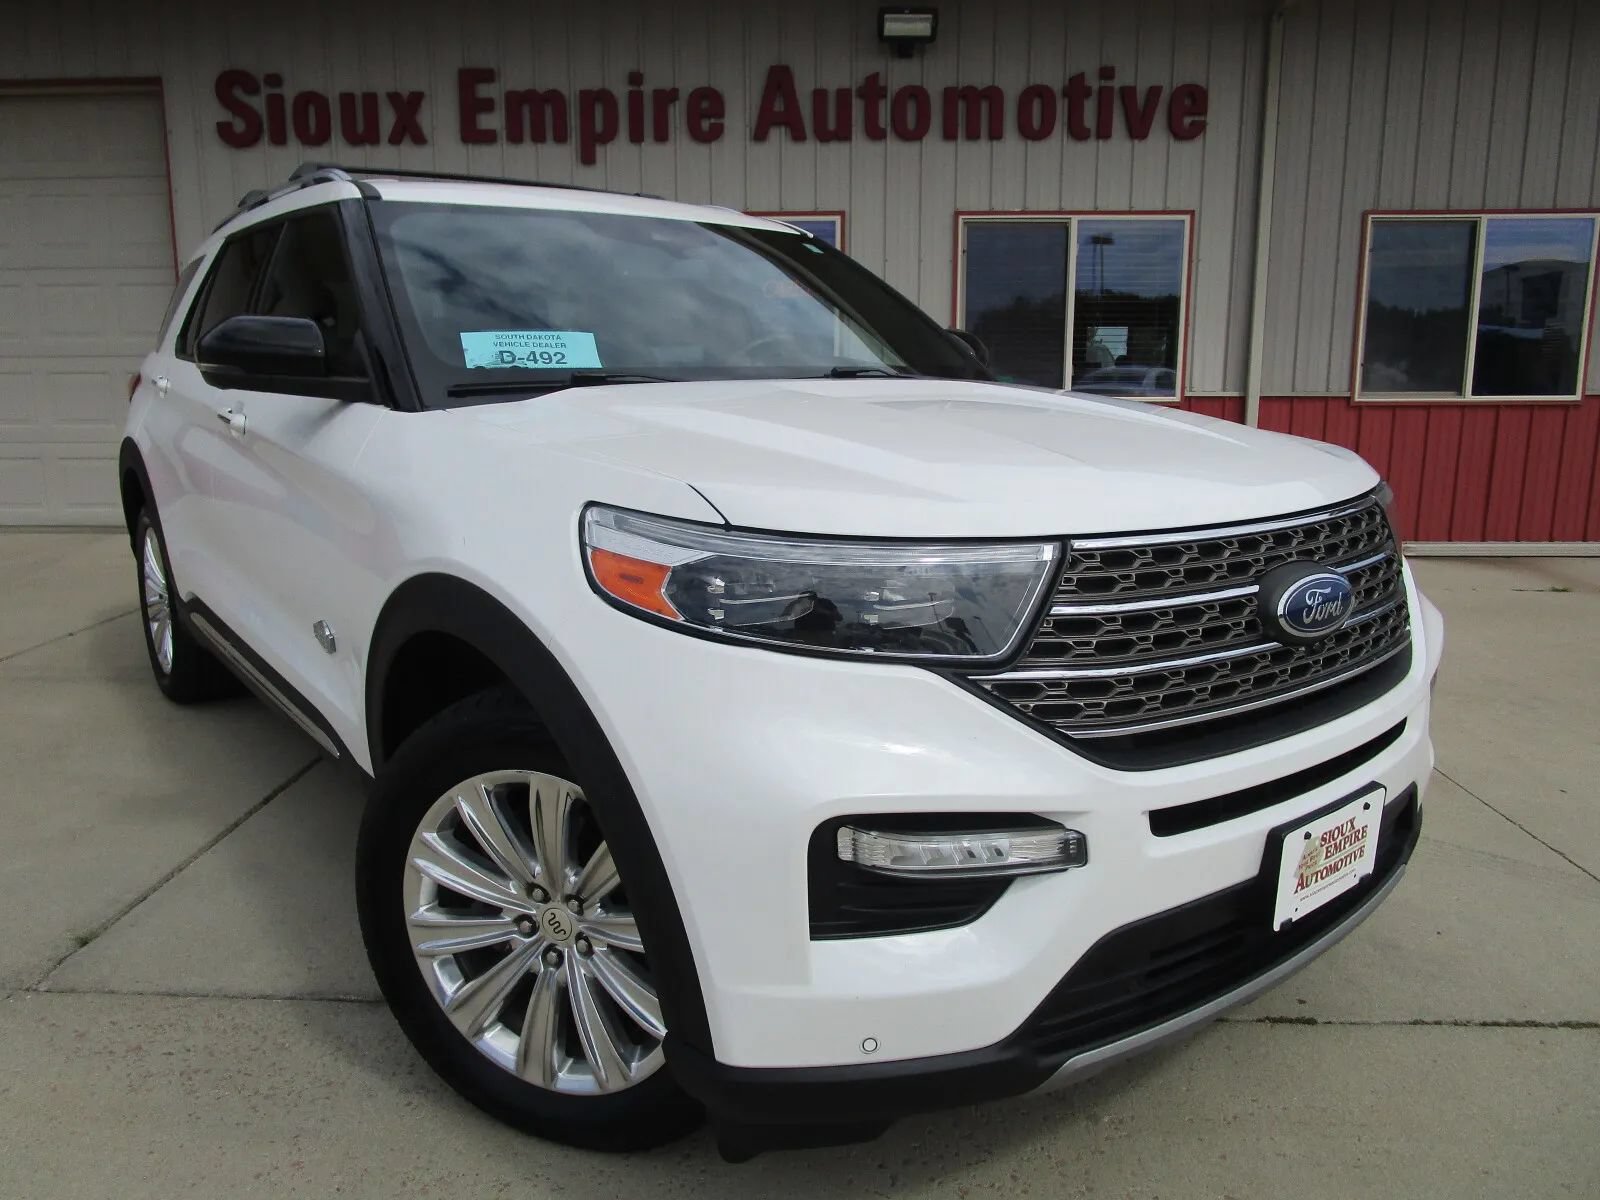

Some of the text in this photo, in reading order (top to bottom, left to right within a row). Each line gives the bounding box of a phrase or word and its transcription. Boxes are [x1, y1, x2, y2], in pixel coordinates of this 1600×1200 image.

[215, 65, 1209, 165] Sioux Empire Automotive
[499, 350, 568, 365] D-492
[532, 341, 567, 349] DEALER
[1303, 587, 1343, 624] Ford
[1320, 816, 1356, 848] SIOUX
[1323, 824, 1368, 861] EMPIRE
[1293, 845, 1366, 895] AUTOMOTIVE
